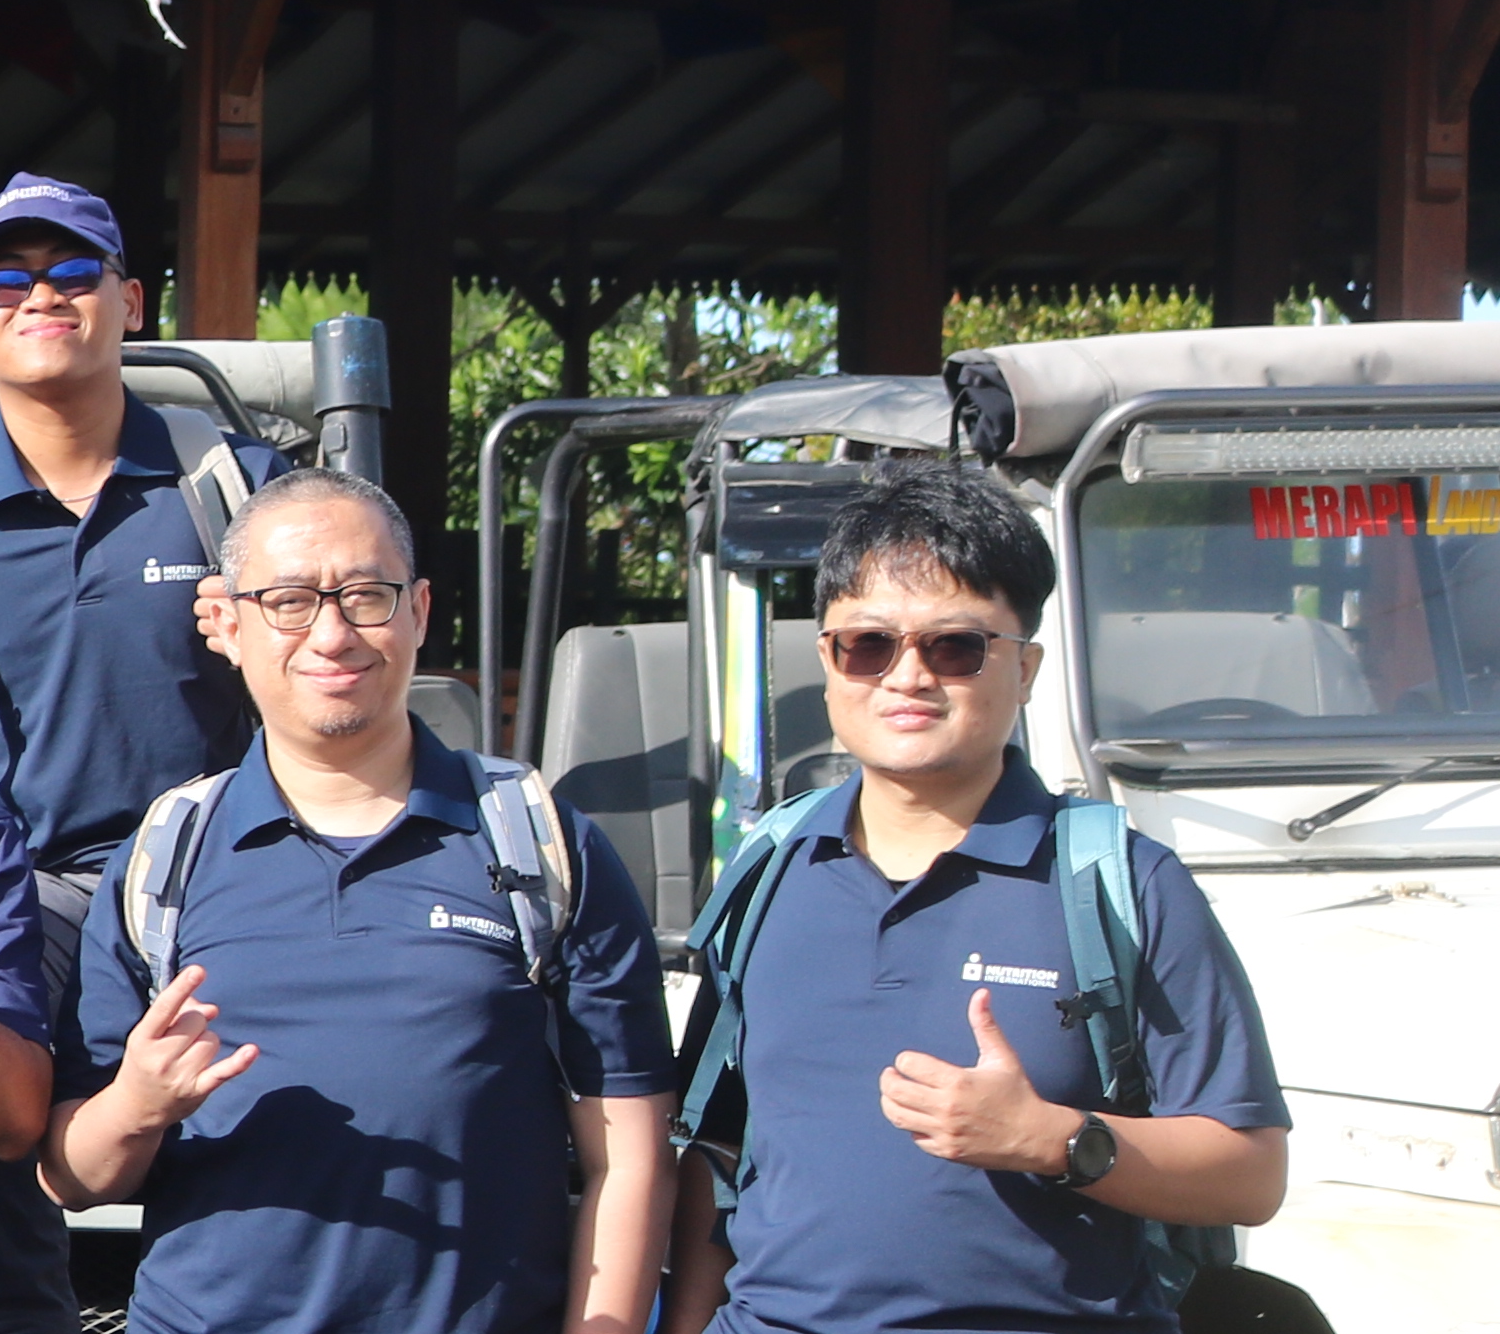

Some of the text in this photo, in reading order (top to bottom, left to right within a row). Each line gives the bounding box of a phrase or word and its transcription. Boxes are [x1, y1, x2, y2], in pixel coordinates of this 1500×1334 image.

[1250, 475, 1500, 540] MERAPI LAND
[452, 914, 516, 939] NUTRITION
[983, 975, 1058, 989] INTERNATIONAL
[985, 965, 1059, 982] NUTRITION
